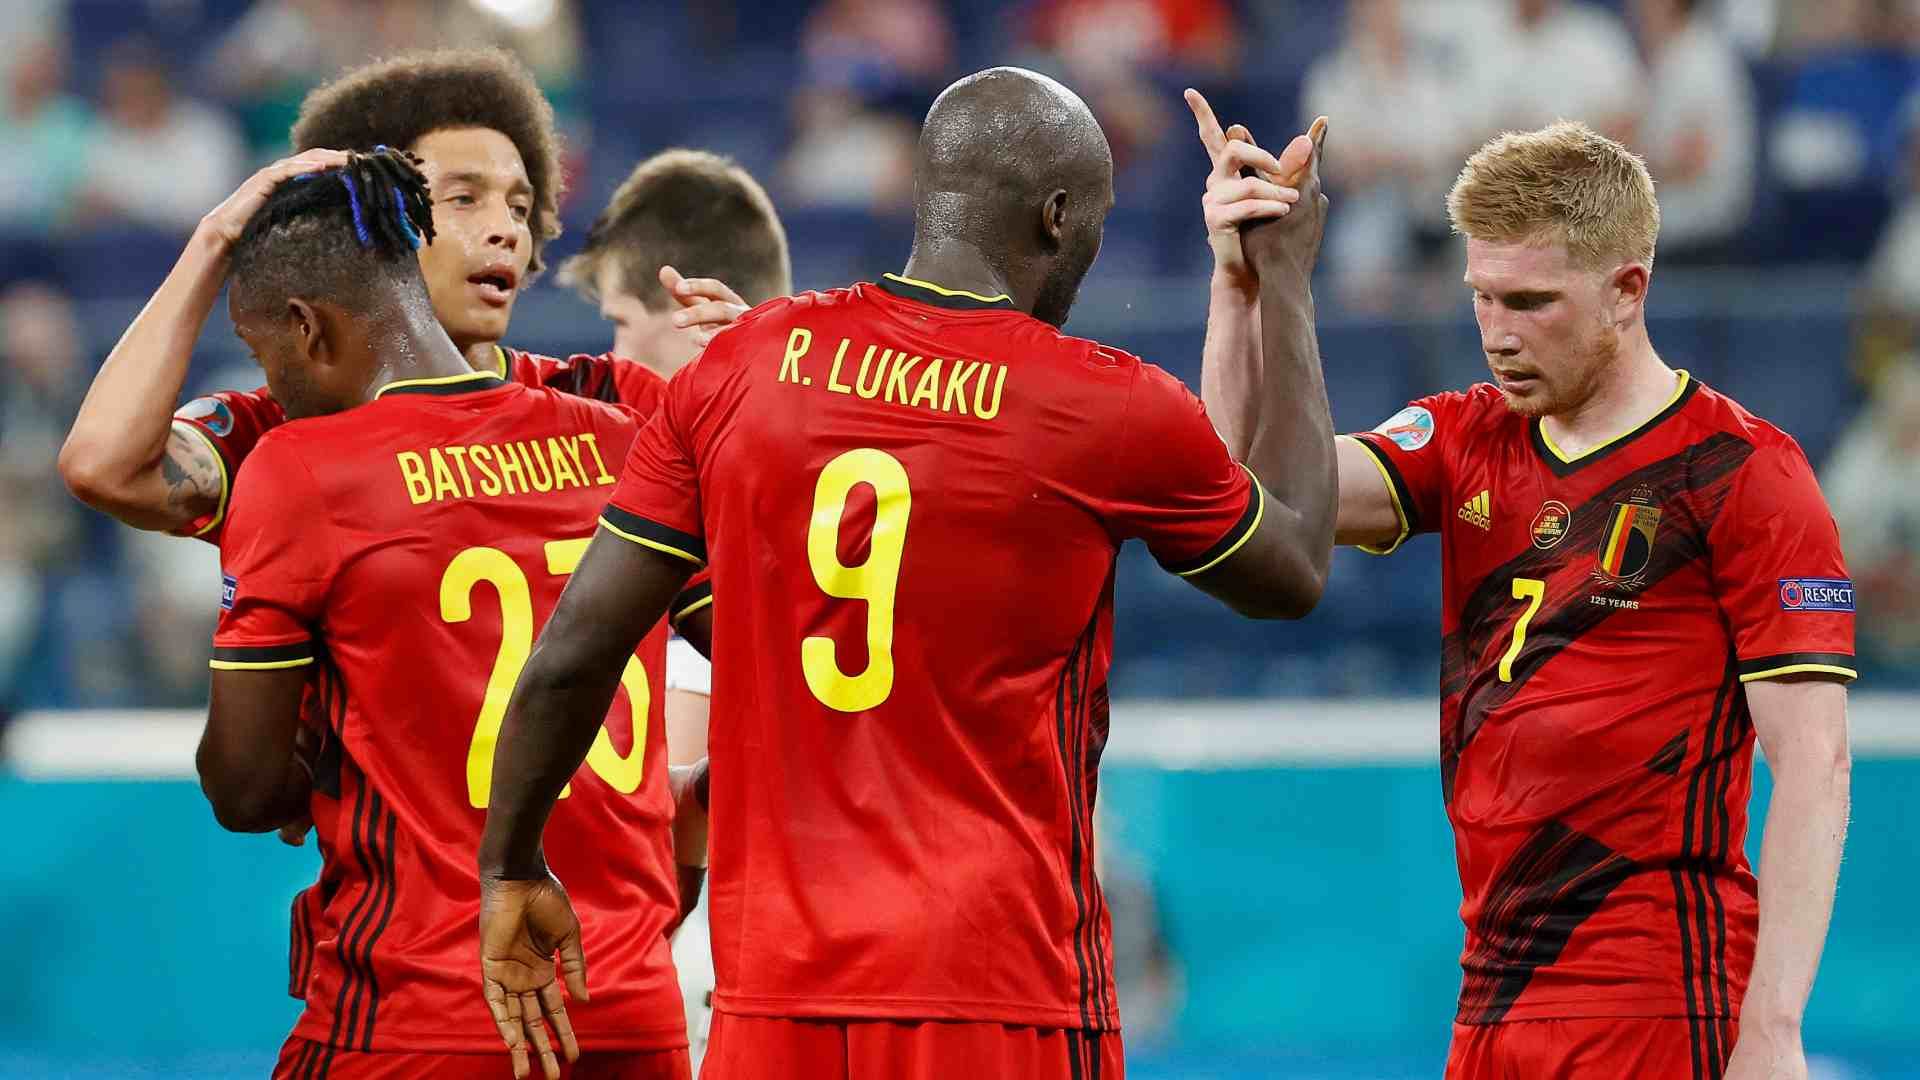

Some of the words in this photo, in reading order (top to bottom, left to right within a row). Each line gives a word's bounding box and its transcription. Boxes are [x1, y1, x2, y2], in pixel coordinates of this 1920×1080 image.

[778, 327, 812, 386] R.
[827, 338, 1008, 420] LUKAKU
[397, 433, 615, 505] BATSHUAYI
[1457, 506, 1490, 531] adidas
[801, 447, 912, 712] 9
[1590, 595, 1606, 606] 125
[1608, 598, 1640, 610] YEARS
[1804, 587, 1853, 603] RESPECT
[1498, 577, 1545, 683] 7
